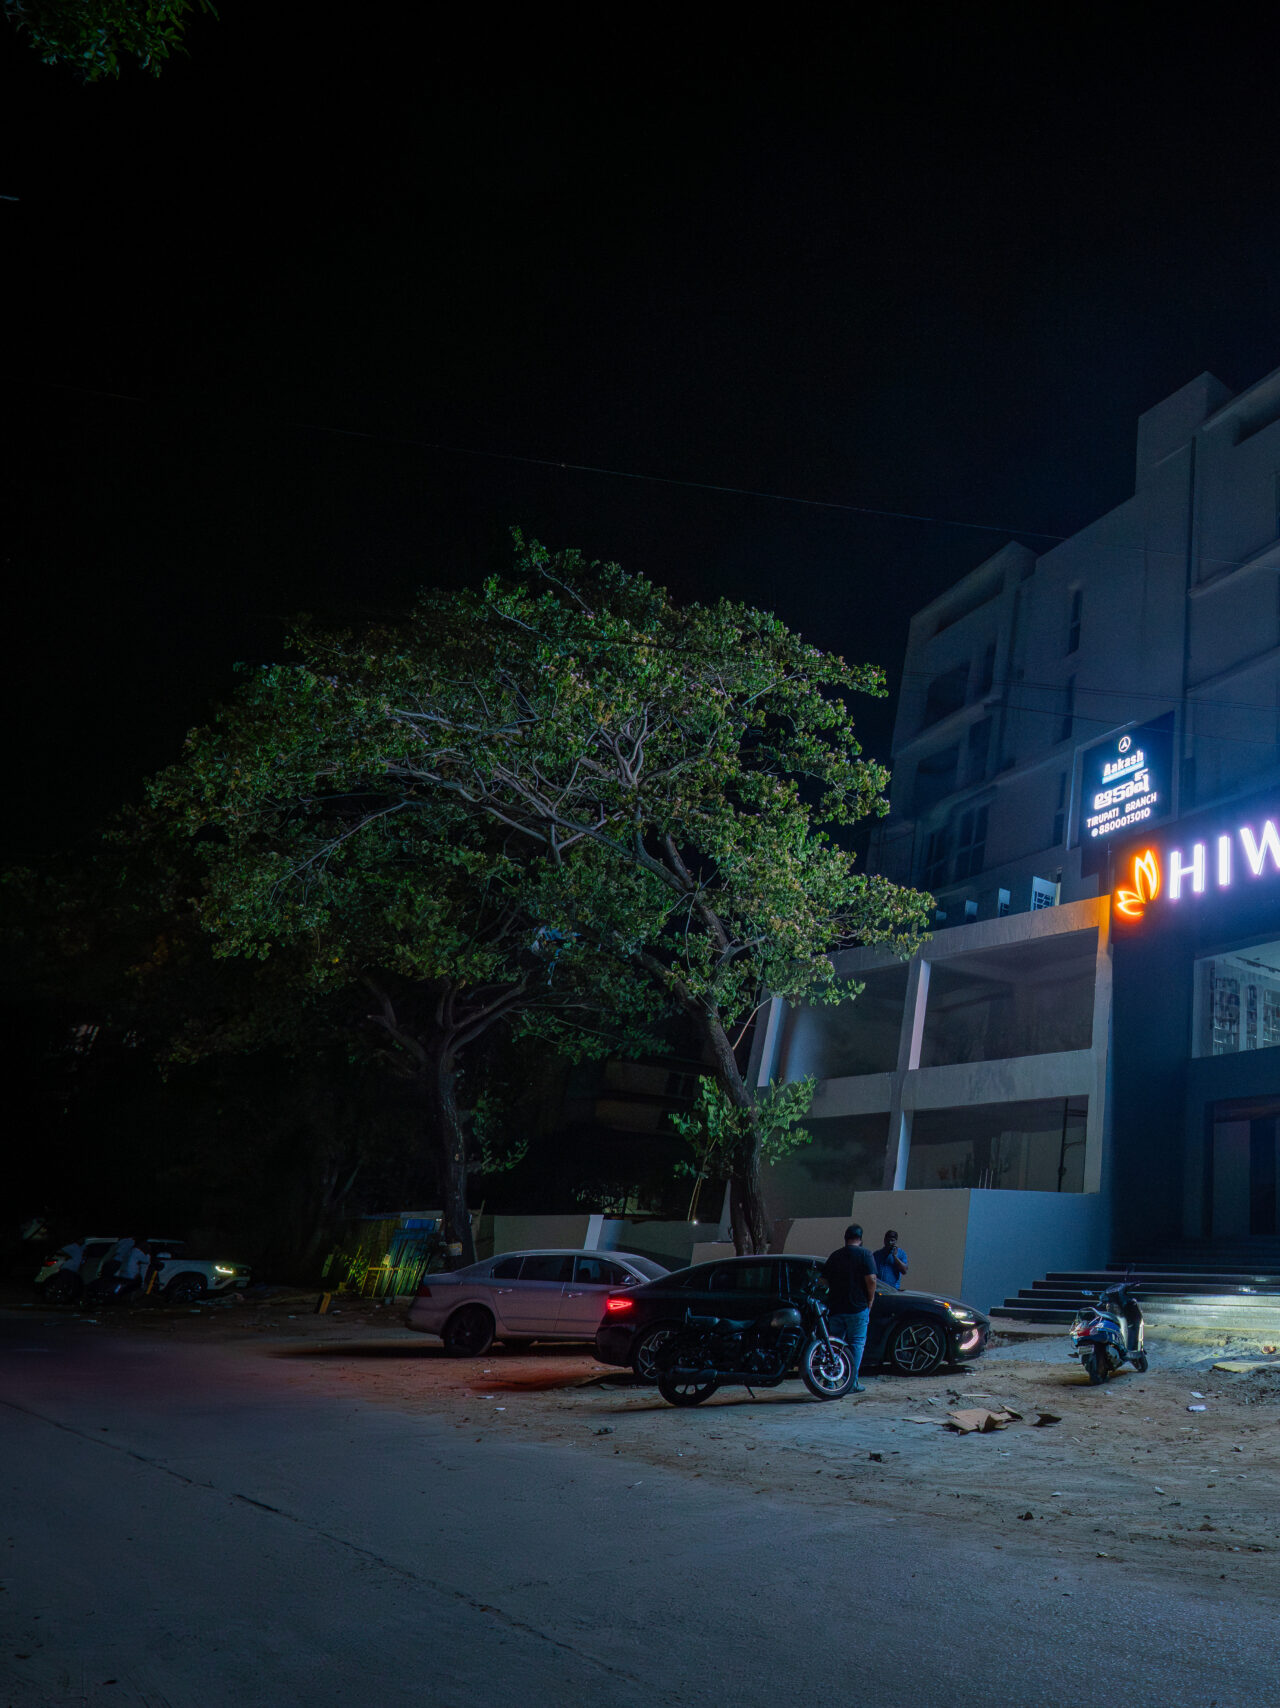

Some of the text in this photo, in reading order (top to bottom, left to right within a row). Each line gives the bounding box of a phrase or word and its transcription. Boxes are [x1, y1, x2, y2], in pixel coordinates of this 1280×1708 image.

[1103, 750, 1144, 775] Aakash
[1086, 792, 1157, 827] TIRUPATI BRANCH
[1099, 807, 1151, 835] 8800013010
